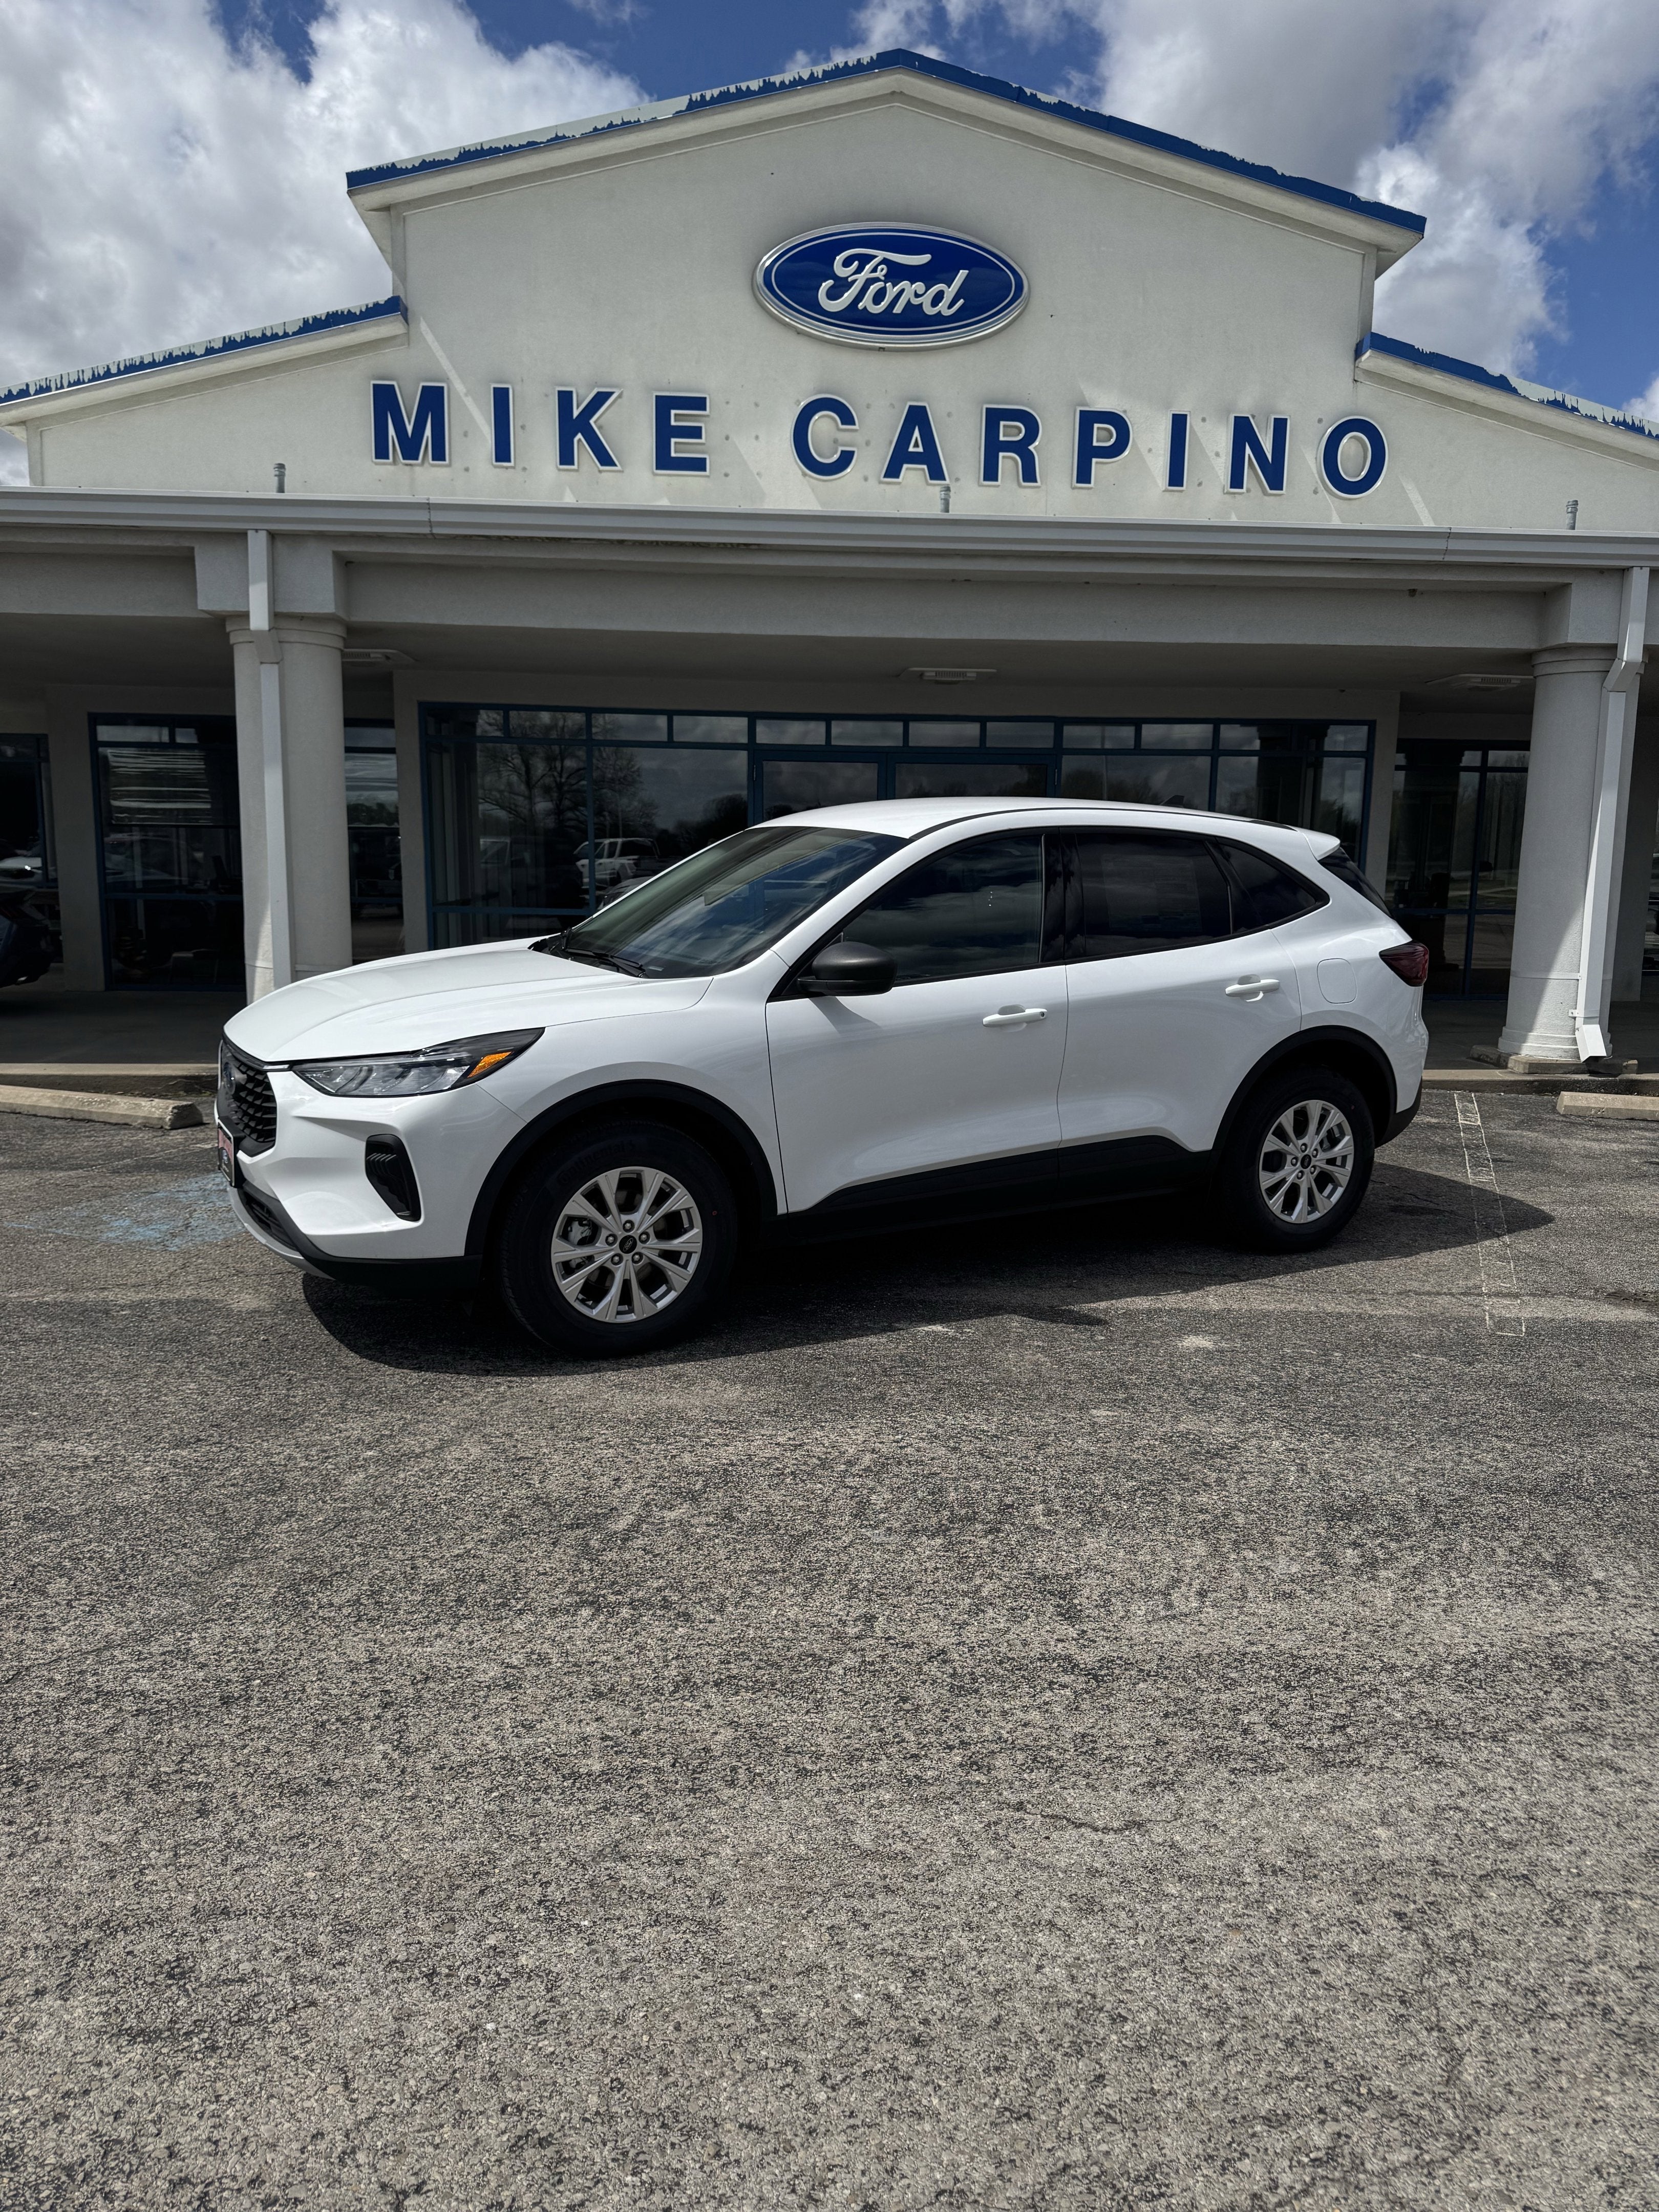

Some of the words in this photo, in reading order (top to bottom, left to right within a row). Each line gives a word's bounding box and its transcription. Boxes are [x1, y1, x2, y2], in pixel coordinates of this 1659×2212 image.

[819, 248, 969, 316] Ford
[370, 380, 710, 476] MIKE
[790, 393, 1389, 499] CARPINO
